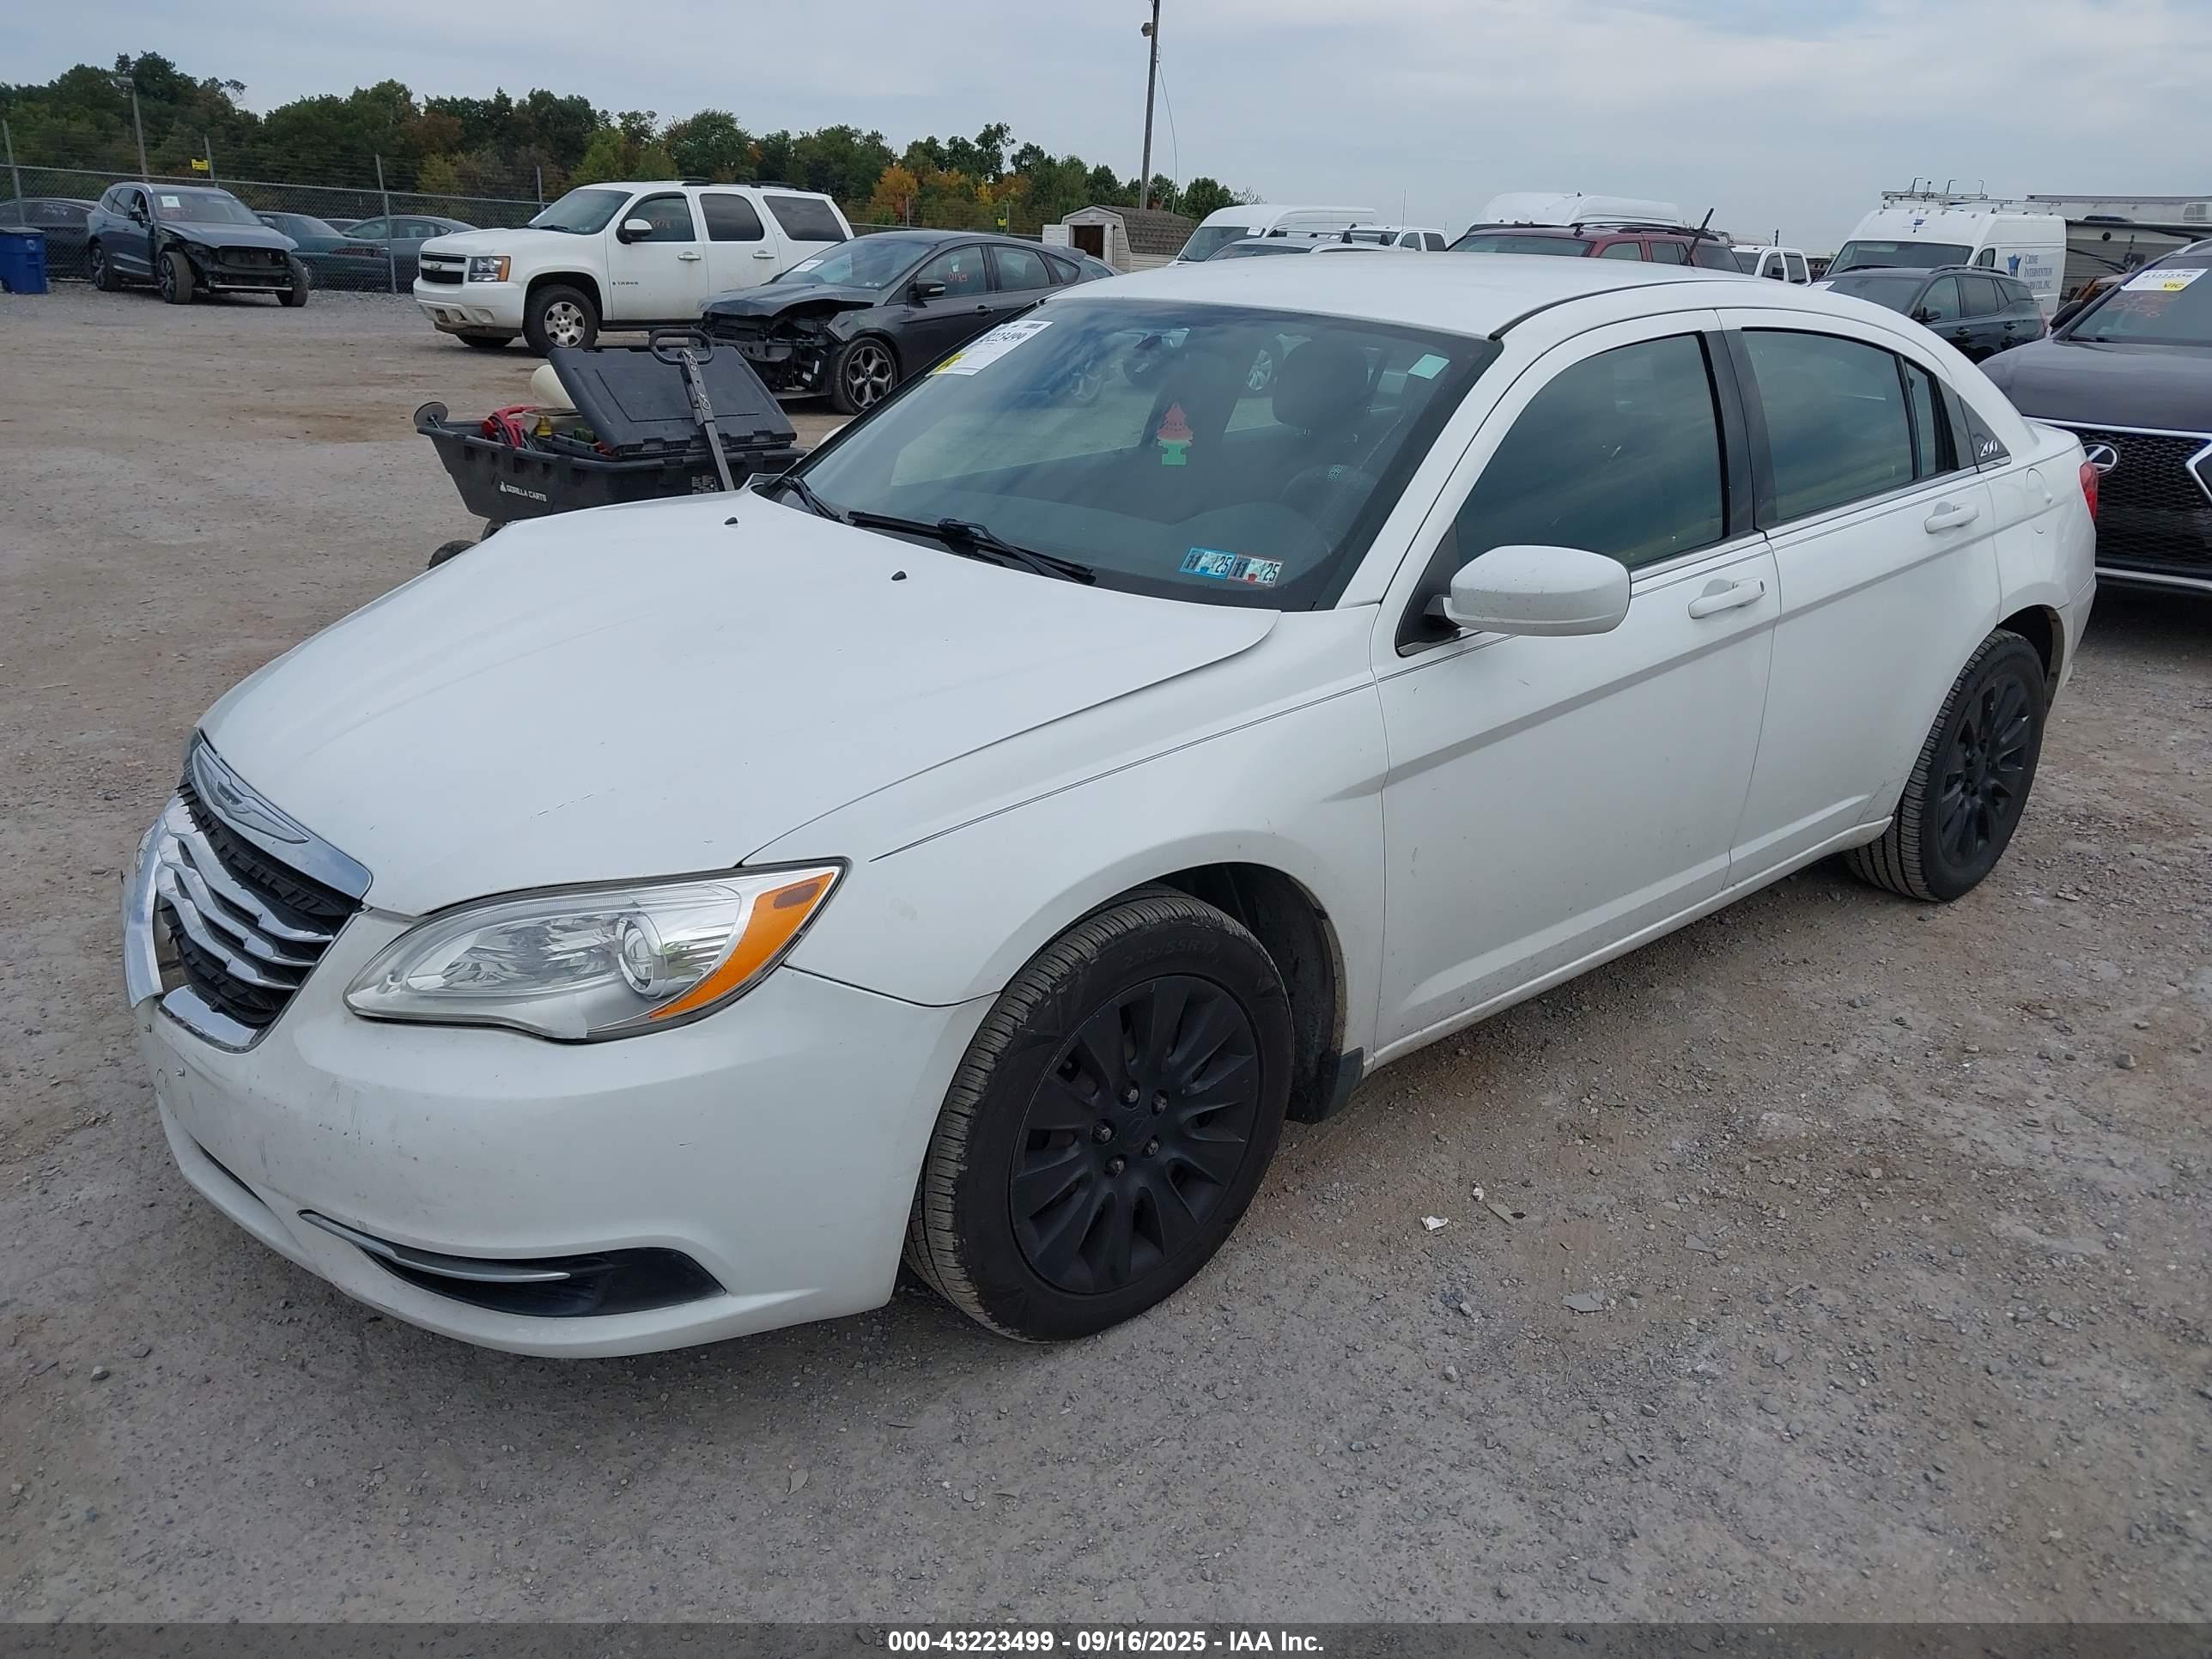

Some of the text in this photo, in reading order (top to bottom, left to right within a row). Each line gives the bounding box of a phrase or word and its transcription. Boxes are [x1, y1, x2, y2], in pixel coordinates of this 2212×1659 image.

[507, 484, 547, 502] GORILLA CARTS
[1215, 556, 1232, 574] 25
[1232, 561, 1280, 582] 11 25
